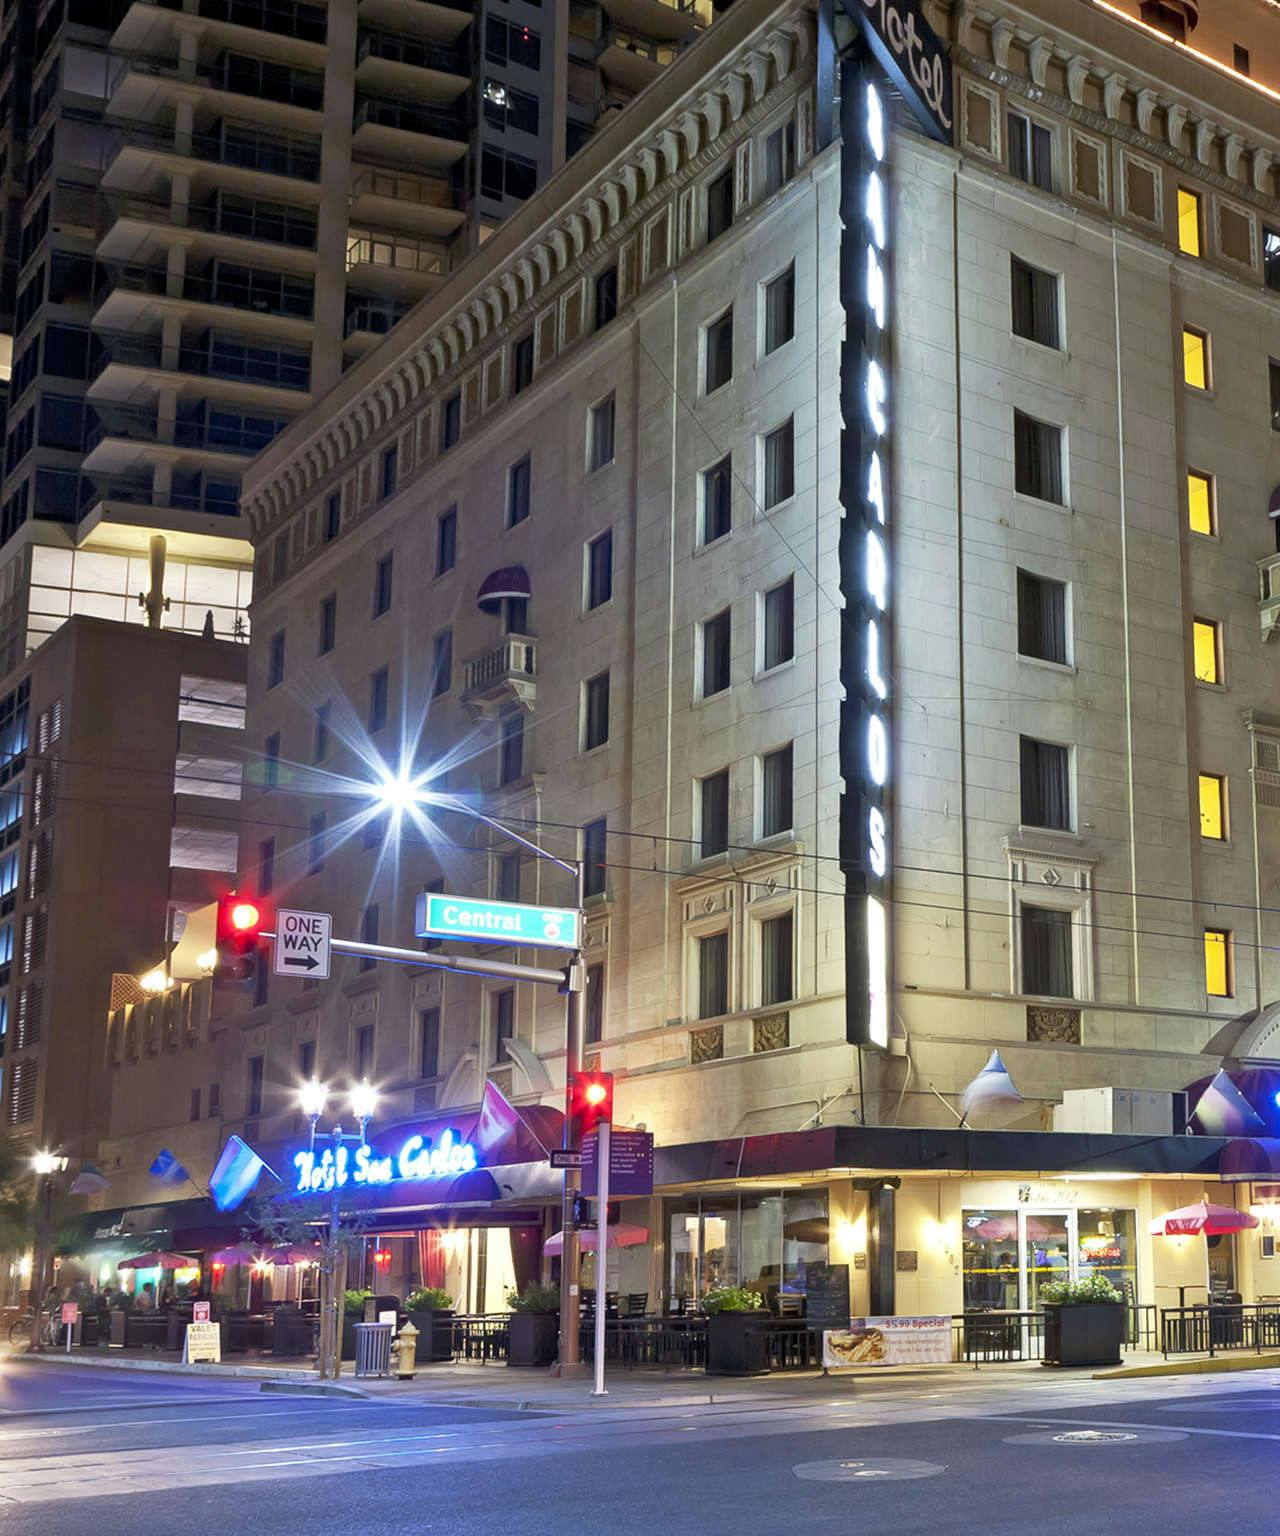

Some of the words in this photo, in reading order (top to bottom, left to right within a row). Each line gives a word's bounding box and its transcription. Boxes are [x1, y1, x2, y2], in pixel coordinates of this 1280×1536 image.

[285, 916, 323, 935] ONE
[443, 906, 522, 931] Central
[283, 934, 323, 952] WAY
[354, 1144, 392, 1182] San
[399, 1128, 477, 1177] Carlos
[912, 1318, 945, 1330] Special
